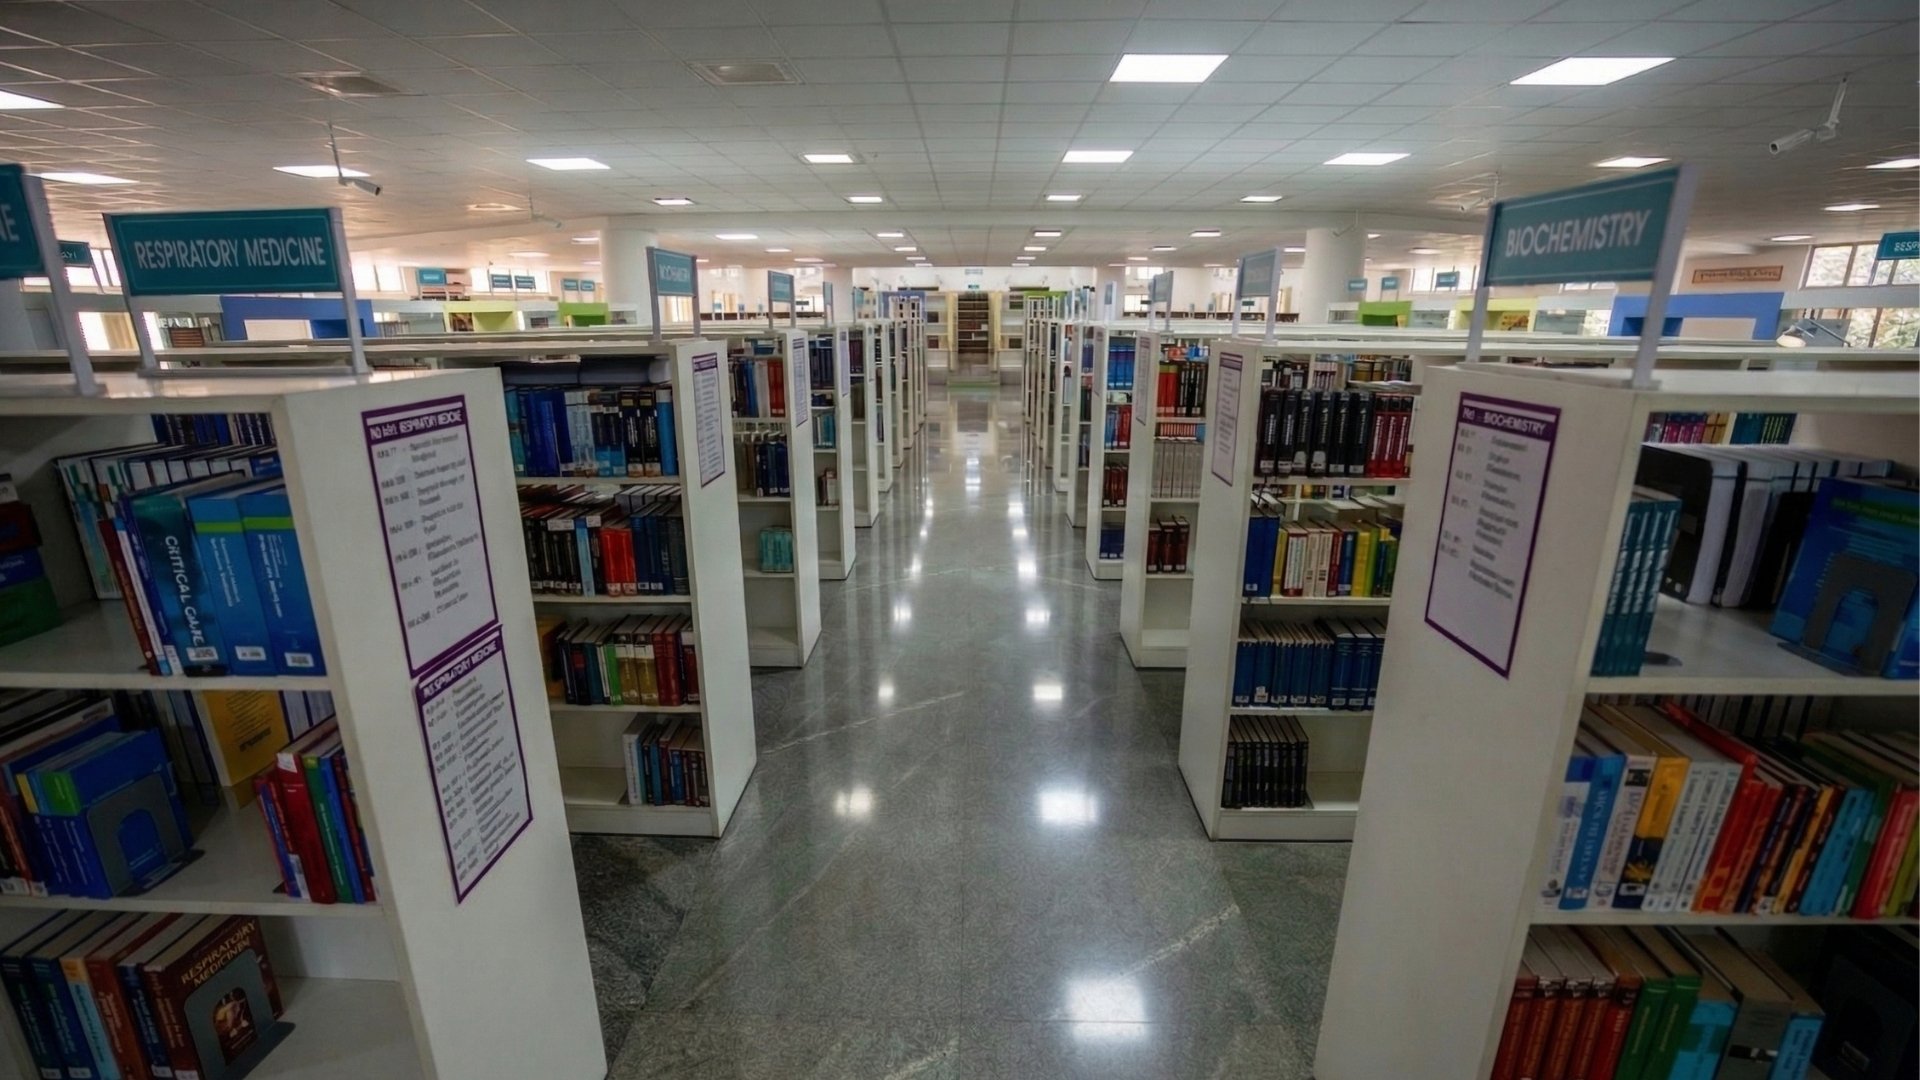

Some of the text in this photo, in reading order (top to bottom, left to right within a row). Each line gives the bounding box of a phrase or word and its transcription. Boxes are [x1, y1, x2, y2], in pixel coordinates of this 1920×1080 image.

[134, 236, 326, 269] RESPIRATORY MEDICINE
[1505, 209, 1652, 258] BIOCHEMISTRY
[165, 535, 192, 603] CRITICAL
[180, 921, 256, 985] RESPIRATORY
